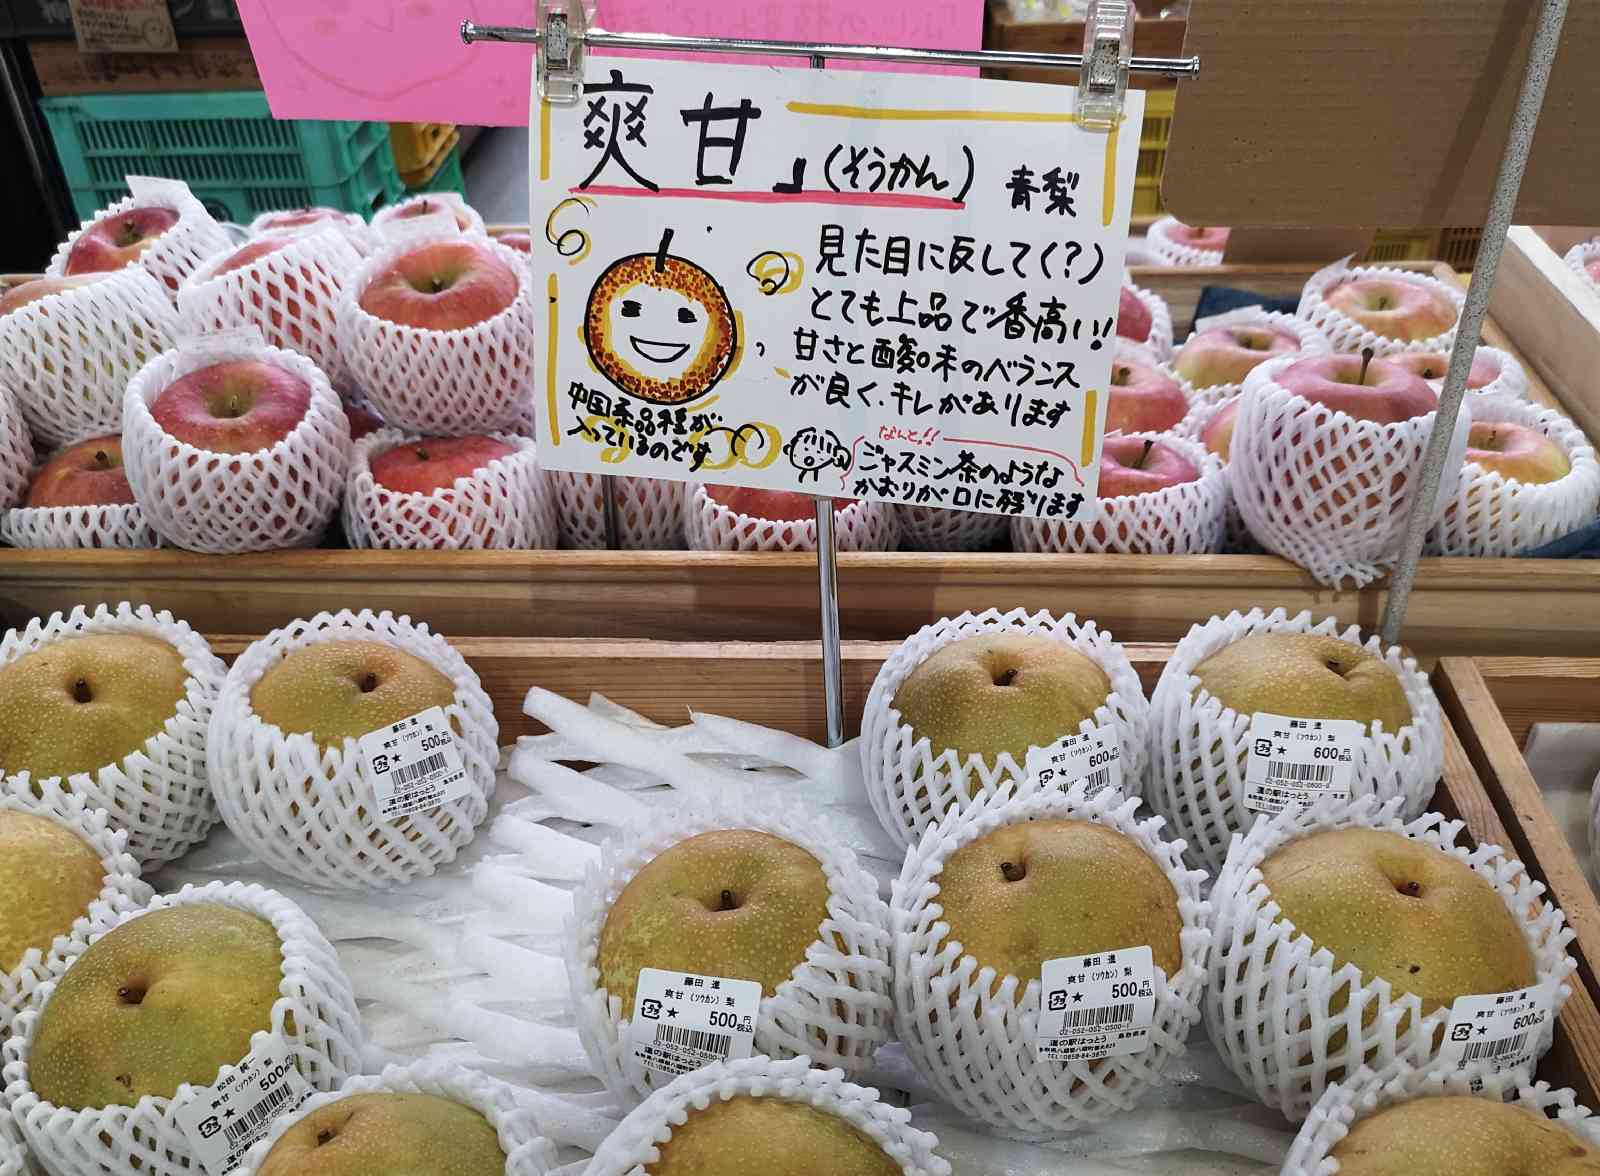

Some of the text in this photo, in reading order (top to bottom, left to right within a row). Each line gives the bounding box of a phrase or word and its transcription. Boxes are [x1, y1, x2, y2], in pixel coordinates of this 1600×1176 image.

[1004, 164, 1080, 218] 青梨
[567, 415, 712, 473] 入っているのです
[859, 440, 1065, 489] ジャスミン茶のような
[852, 475, 1086, 519] かおりが口に残ります
